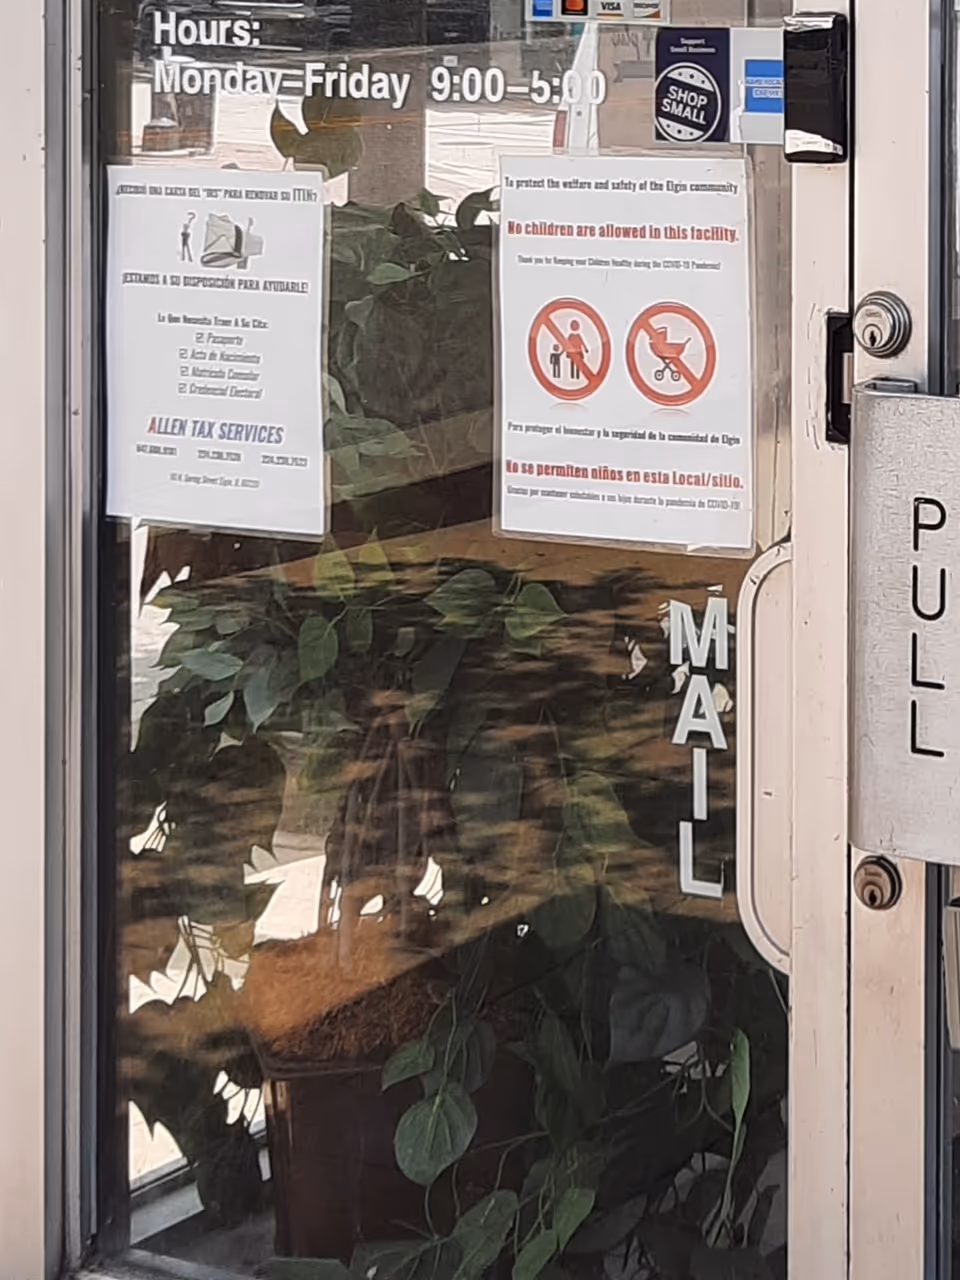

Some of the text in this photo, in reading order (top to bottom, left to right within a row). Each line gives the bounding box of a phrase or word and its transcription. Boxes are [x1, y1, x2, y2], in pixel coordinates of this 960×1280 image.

[601, 2, 622, 11] VISA
[154, 11, 261, 48] Hours:
[668, 85, 708, 107] SHOP
[661, 98, 708, 126] SMALL
[505, 176, 737, 194] To protect the welfare and safety of the Elgin community
[508, 221, 739, 243] No children are allowed in this facility.
[148, 417, 284, 444] ALLEN TAX SERVICES
[506, 459, 744, 489] No se permiten niños en esta Local/sitio.
[911, 496, 947, 758] PULL
[669, 597, 728, 898] MAIL
